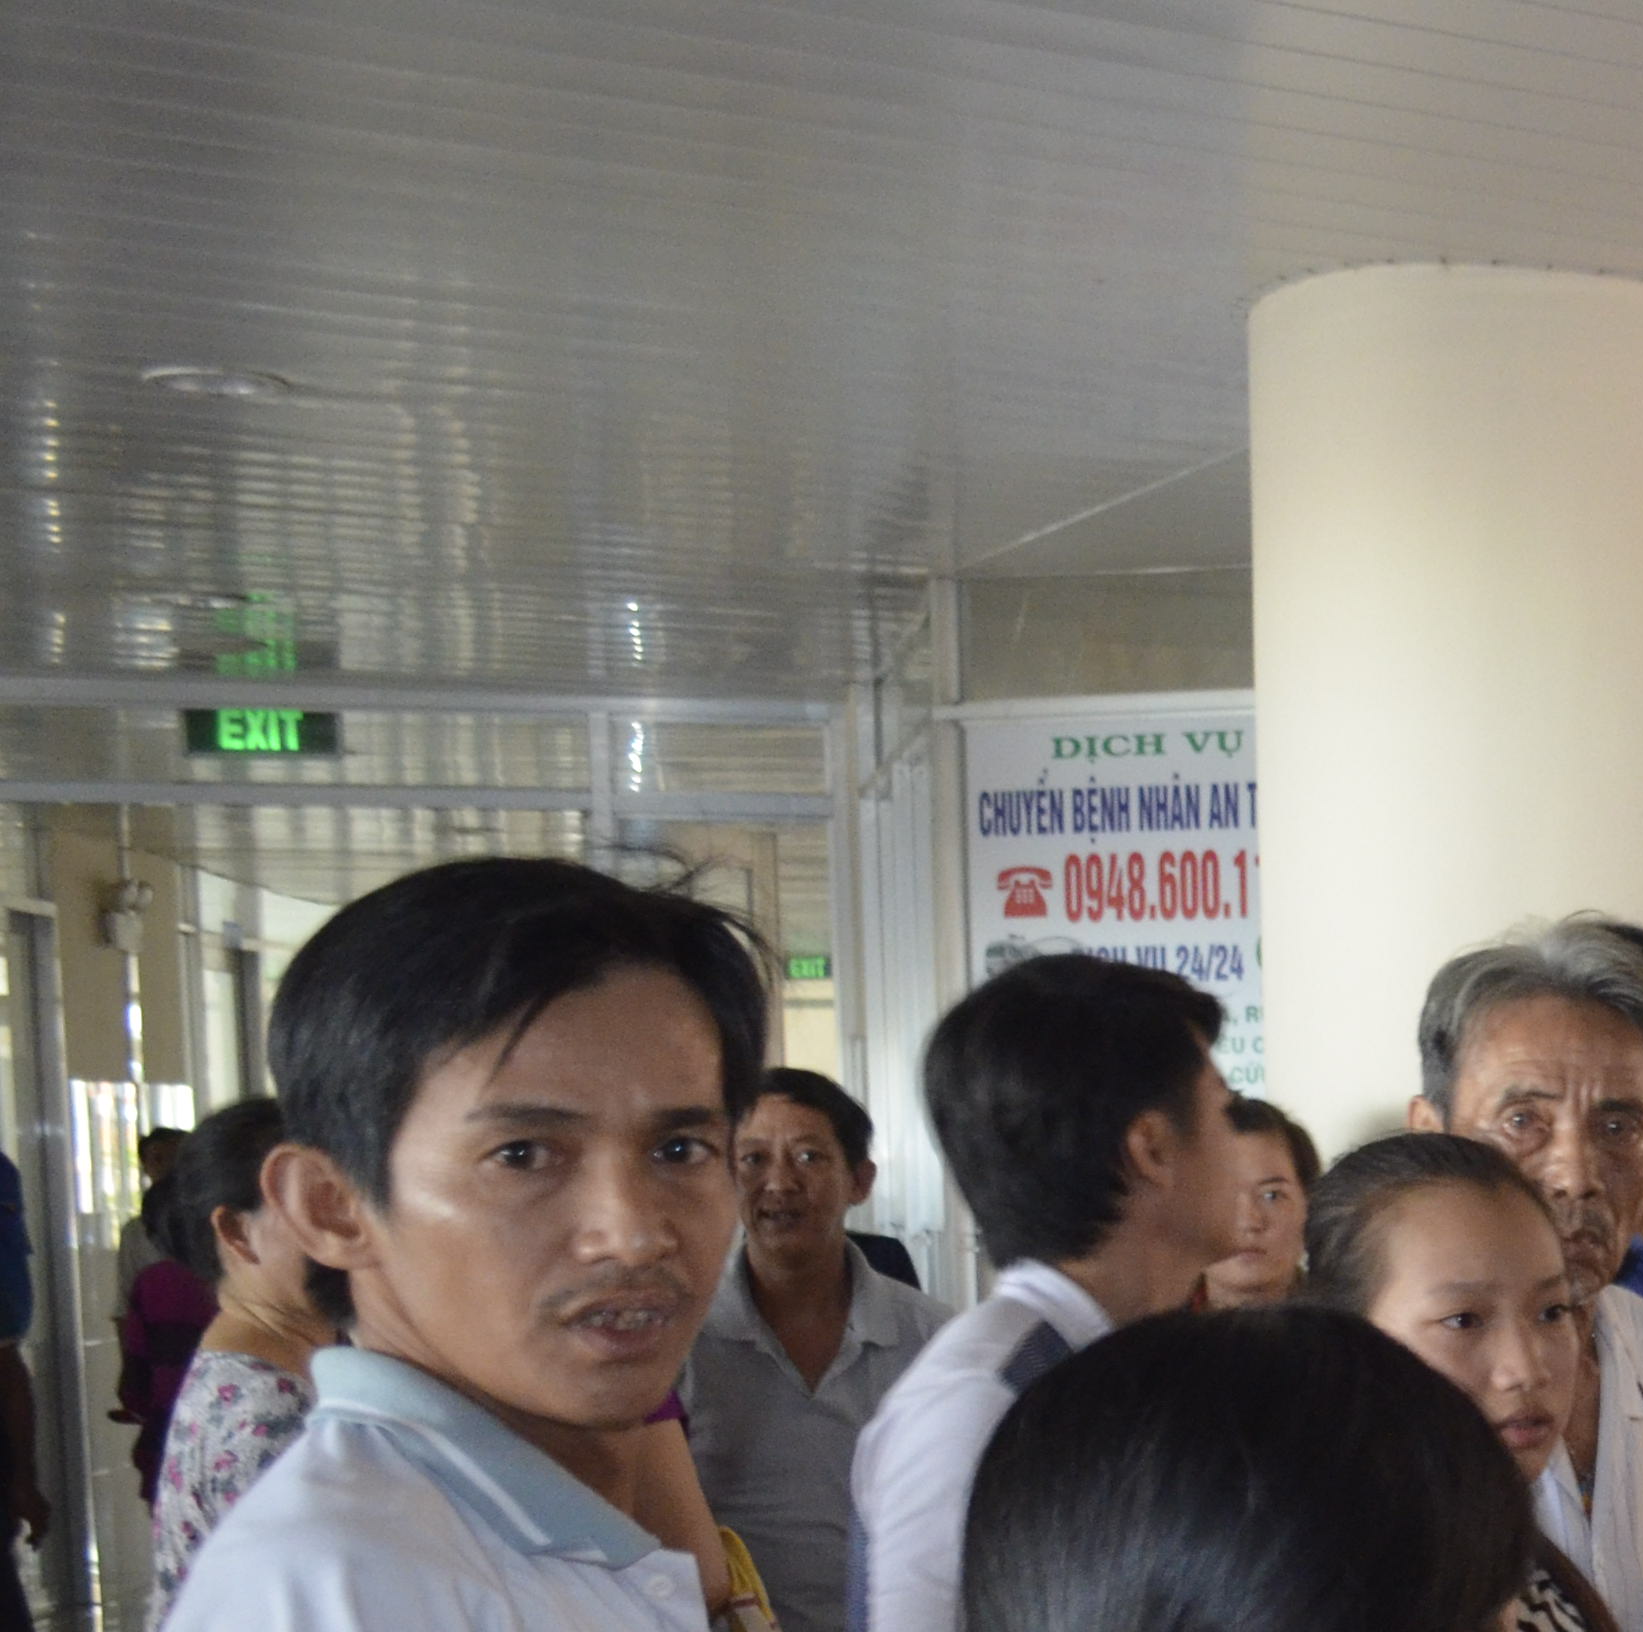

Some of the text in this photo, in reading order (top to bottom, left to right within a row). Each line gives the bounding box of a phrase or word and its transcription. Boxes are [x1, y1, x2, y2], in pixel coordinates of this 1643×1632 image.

[217, 708, 304, 751] EXIT
[1051, 730, 1244, 763] DỊCH VỤ
[1072, 776, 1132, 844] BỆNH
[1139, 772, 1201, 833] NHÂN
[1208, 782, 1240, 830] AN
[1064, 849, 1259, 923] 0948.600.1
[1175, 943, 1245, 982] 24/24
